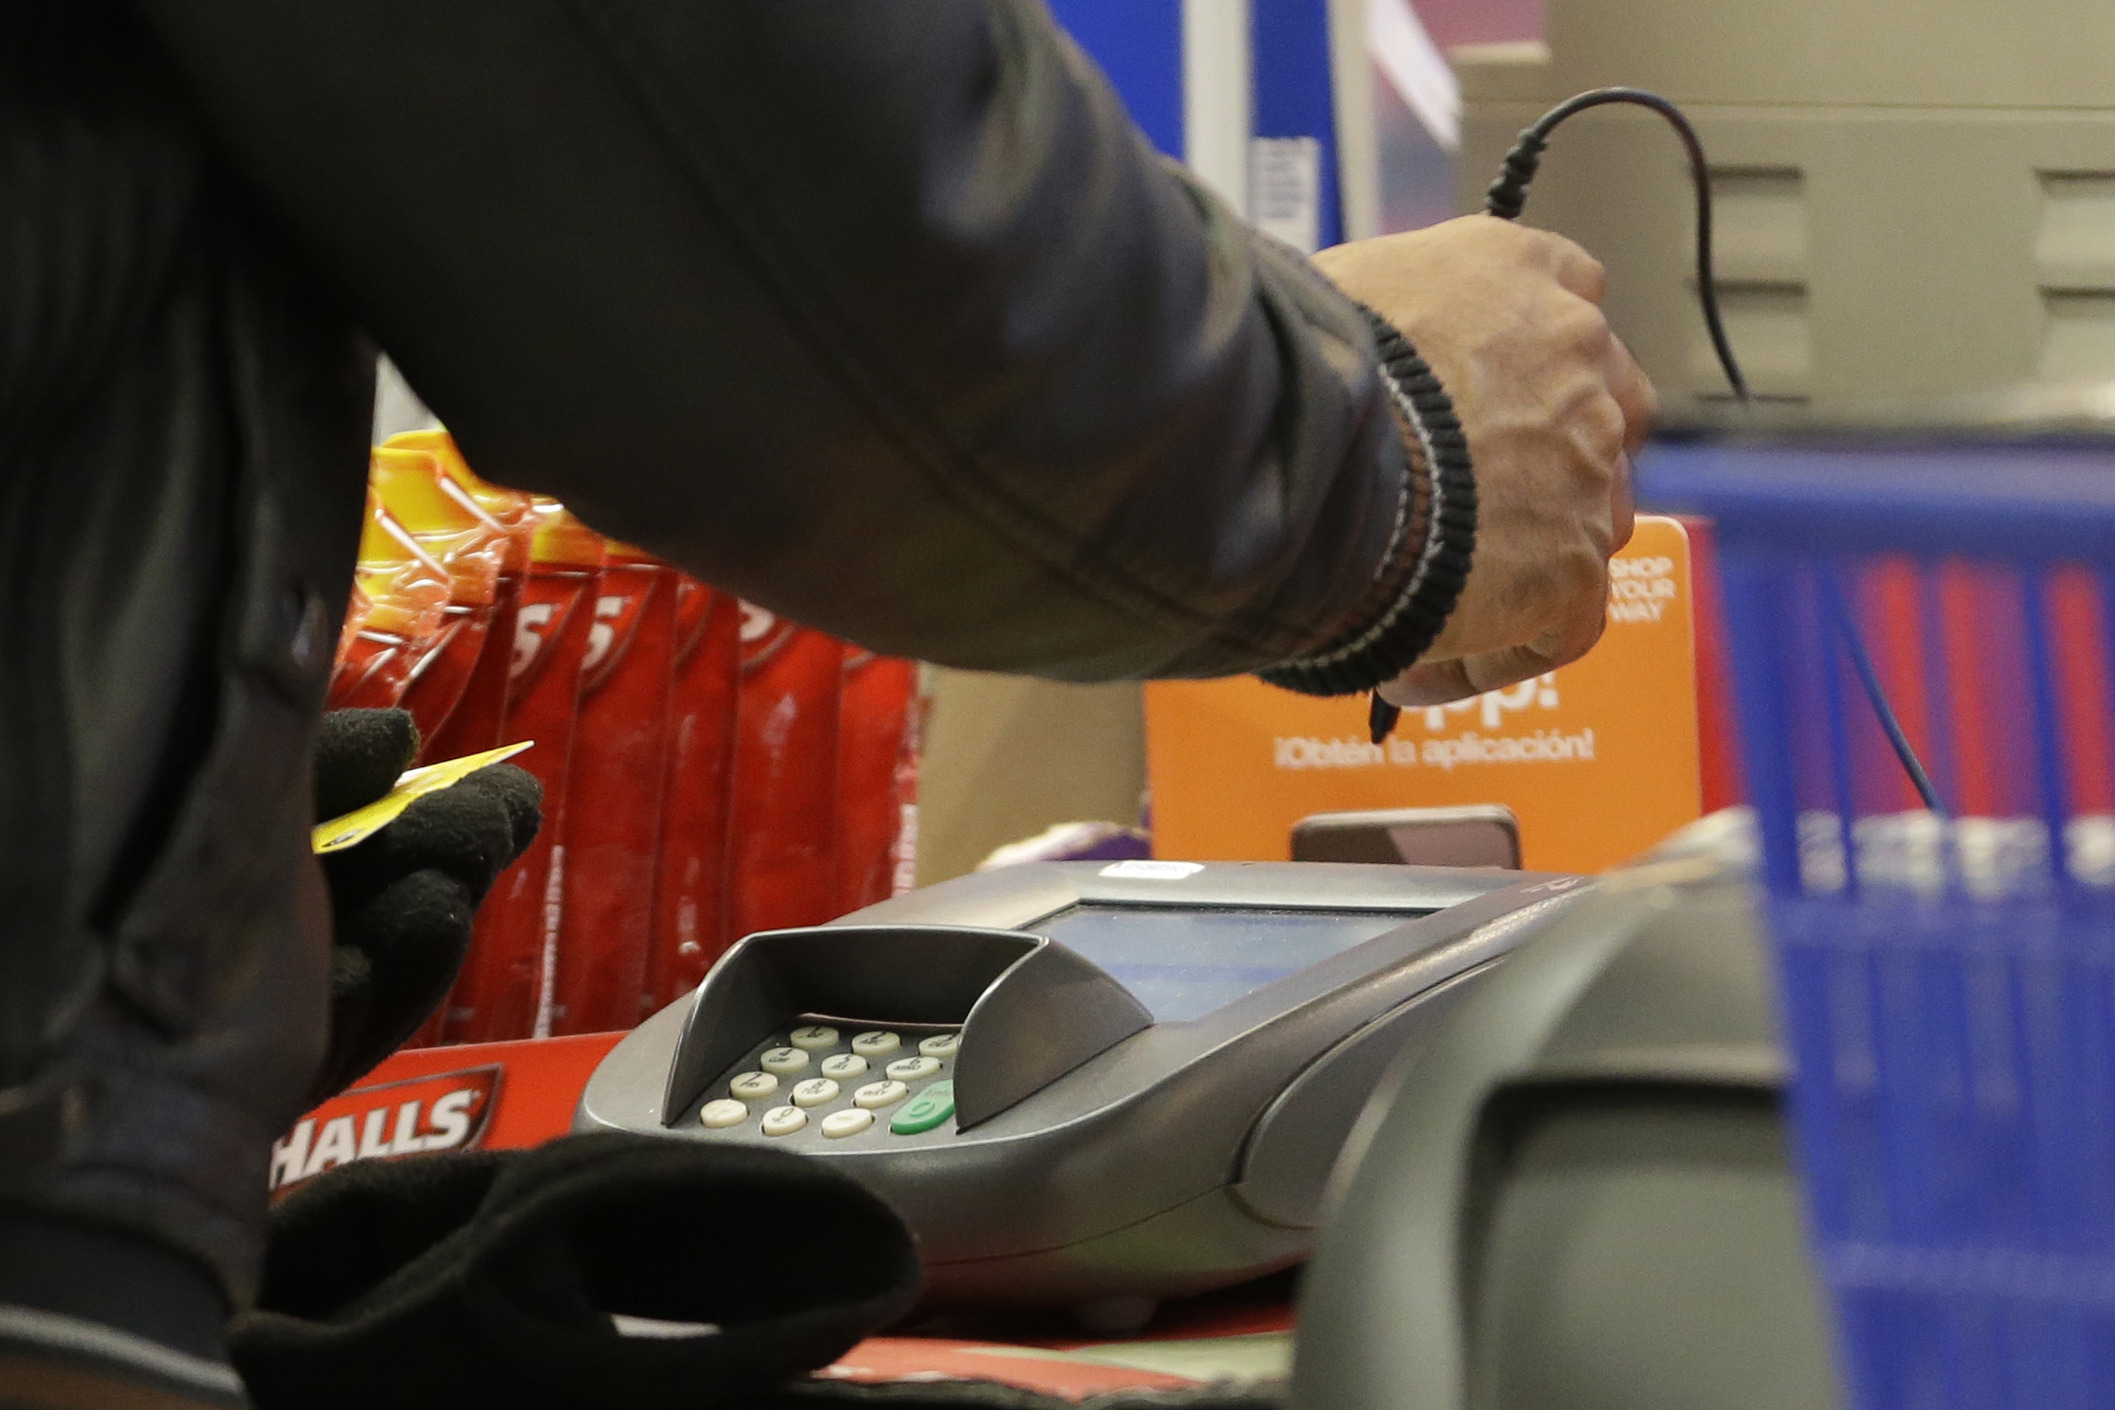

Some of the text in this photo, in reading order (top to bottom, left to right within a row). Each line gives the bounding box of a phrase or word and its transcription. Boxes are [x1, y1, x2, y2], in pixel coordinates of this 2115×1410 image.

[1608, 556, 1674, 578] SHOP
[1608, 600, 1666, 622] WAY
[1388, 733, 1417, 765] la
[1421, 727, 1595, 770] aplicación!
[269, 1088, 473, 1191] HALLS
